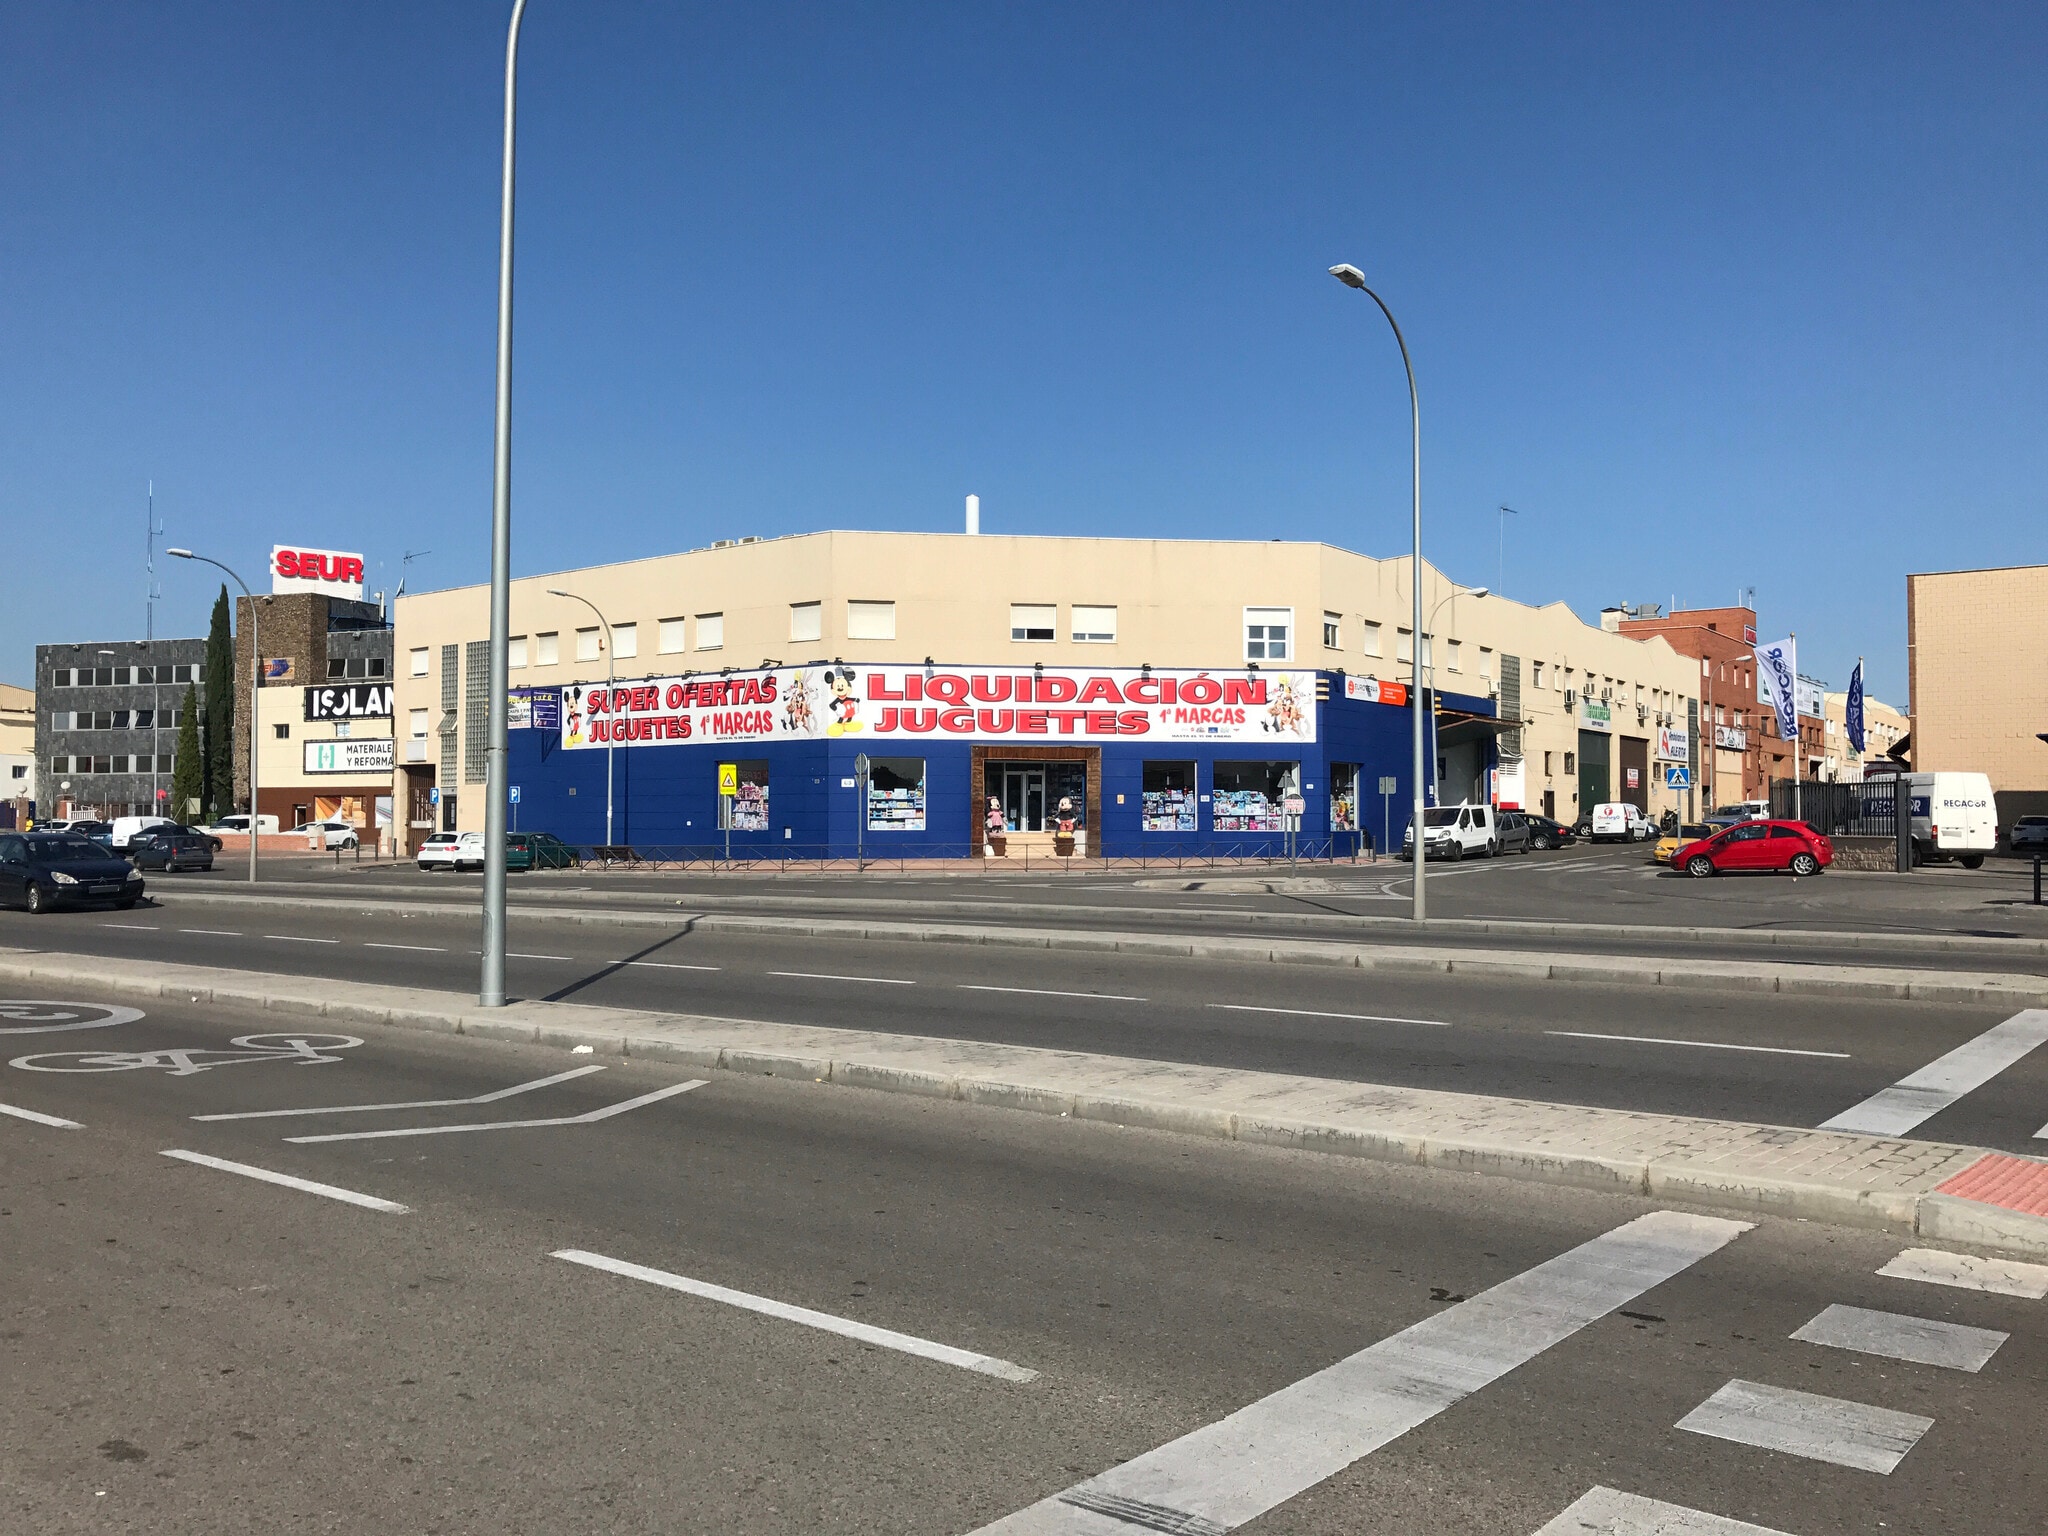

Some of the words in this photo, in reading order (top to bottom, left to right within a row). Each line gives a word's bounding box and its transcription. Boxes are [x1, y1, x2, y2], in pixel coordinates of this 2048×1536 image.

[275, 550, 364, 583] SEUR
[587, 685, 660, 715] SUPER
[666, 676, 777, 709] OFERTAS
[867, 672, 1267, 706] LIQUIDACIÓN
[589, 715, 692, 743] JUGUETES
[713, 710, 773, 735] MARCAS
[874, 707, 1150, 735] JUGUETES
[1174, 707, 1246, 724] MARCAS
[346, 743, 392, 754] MATERIALE
[347, 758, 352, 766] Y
[354, 756, 394, 766] REFORMA
[431, 790, 438, 802] P
[511, 788, 518, 802] P
[1943, 799, 1987, 808] RECACOR
